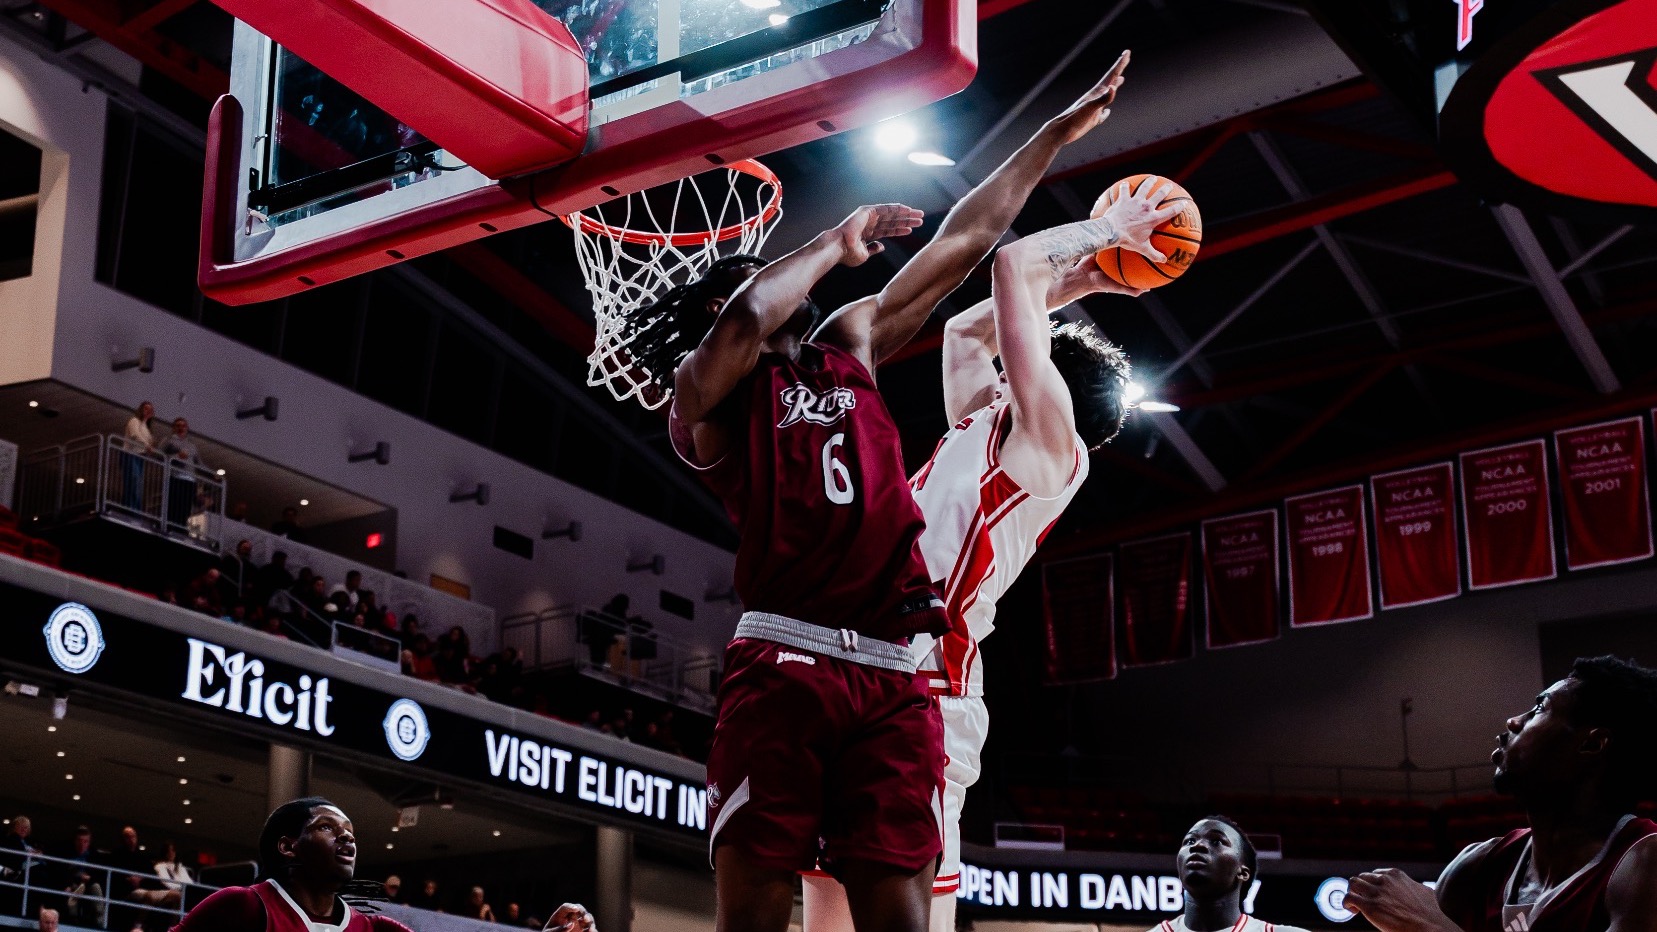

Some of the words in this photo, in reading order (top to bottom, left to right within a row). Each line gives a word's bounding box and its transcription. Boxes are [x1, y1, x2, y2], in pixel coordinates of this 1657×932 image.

[1576, 442, 1623, 458] NCAA
[822, 433, 854, 505] 6
[1481, 464, 1526, 480] NCAA
[1584, 478, 1621, 494] 2001
[1392, 487, 1433, 502] NCAA
[1487, 499, 1527, 516] 2000
[1304, 508, 1346, 524] NCAA
[1399, 521, 1432, 536] 1999
[1221, 532, 1259, 546] NCAA
[181, 637, 336, 737] Elicit
[485, 729, 572, 793] VISIT
[578, 756, 673, 820] ELICIT
[678, 783, 707, 830] IN
[956, 862, 1019, 907] OPEN
[1030, 872, 1069, 908] IN
[1079, 873, 1262, 914] DANBY
